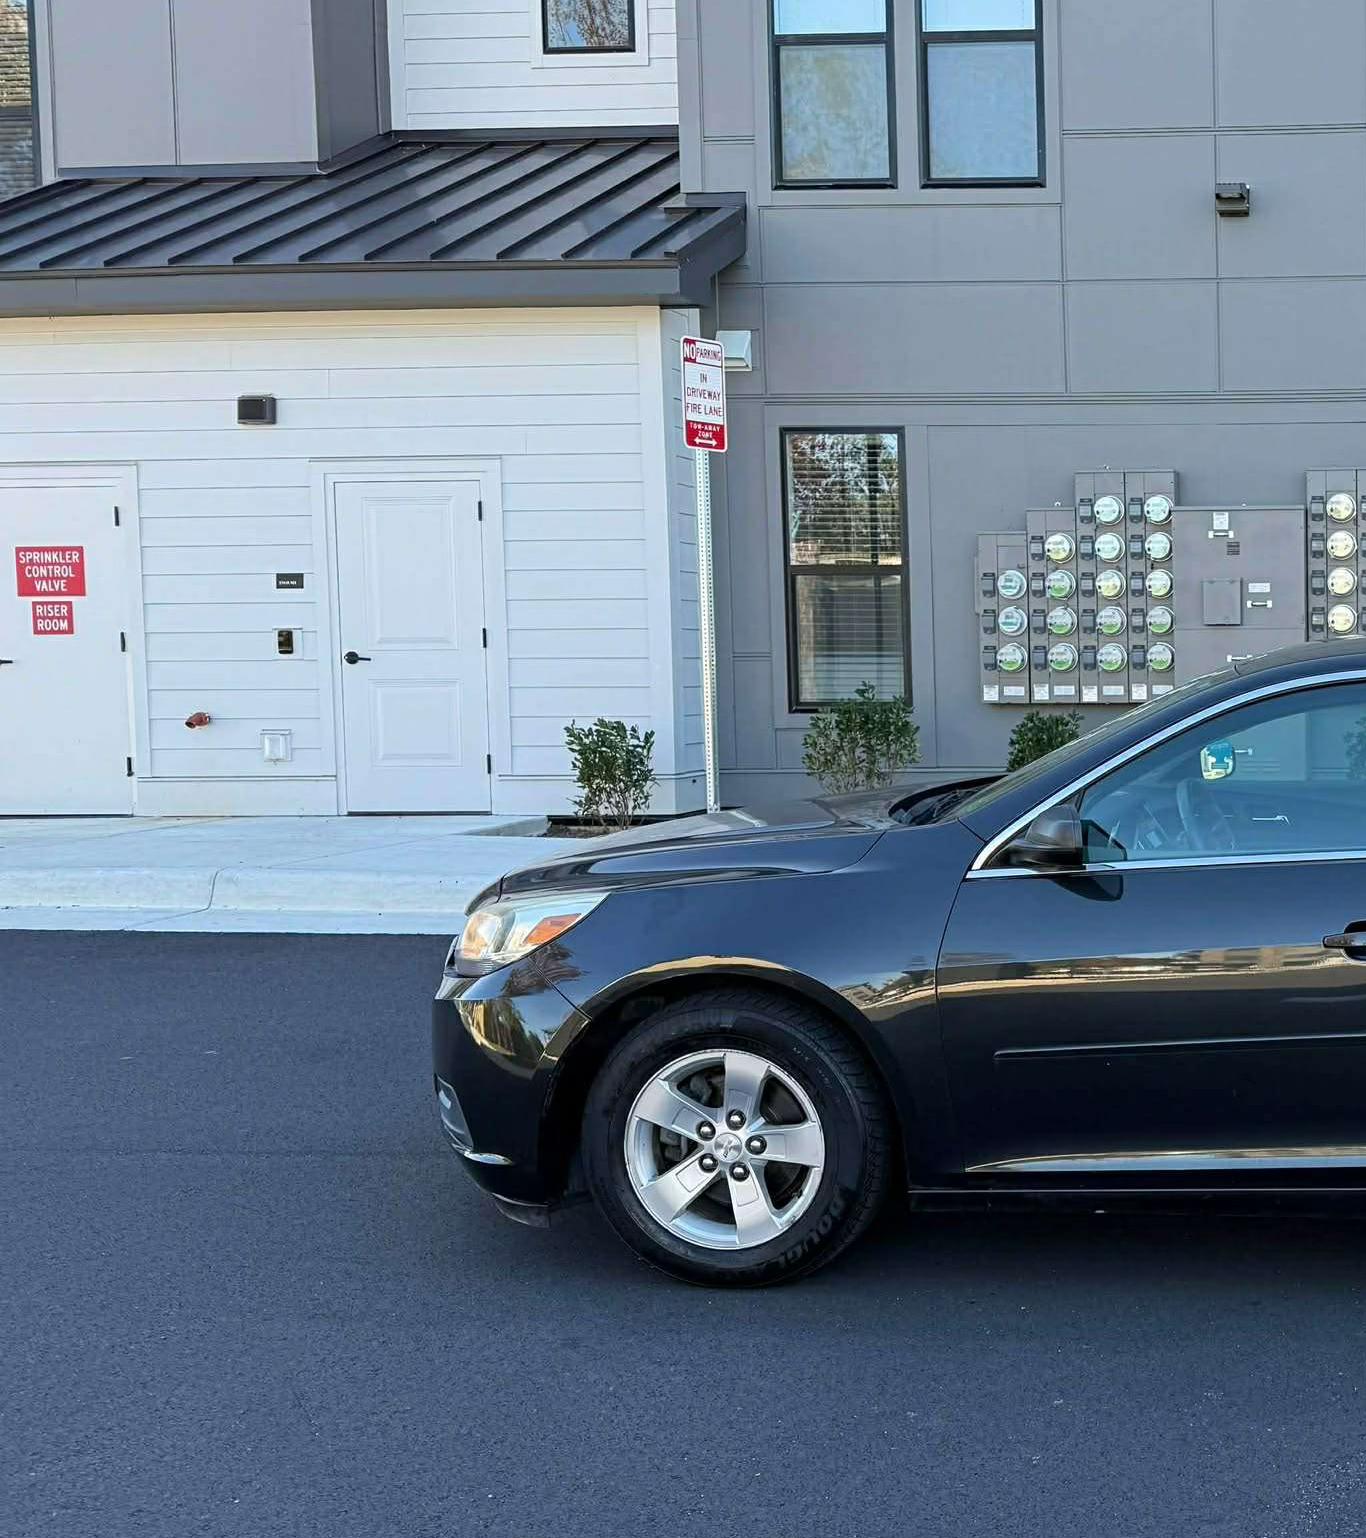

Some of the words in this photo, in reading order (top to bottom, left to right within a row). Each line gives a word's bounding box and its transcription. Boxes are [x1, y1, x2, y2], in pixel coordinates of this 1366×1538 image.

[683, 342, 696, 360] NO
[696, 347, 721, 361] PARKING
[700, 373, 707, 383] IN
[686, 386, 720, 400] DRIVEWAY
[686, 402, 702, 414] FIRE
[704, 403, 723, 417] LANE
[19, 551, 80, 564] SPRINKLER
[25, 565, 75, 578] CONTROL
[34, 580, 68, 592] VALVE
[36, 605, 68, 617] RISER
[37, 619, 68, 631] ROOM
